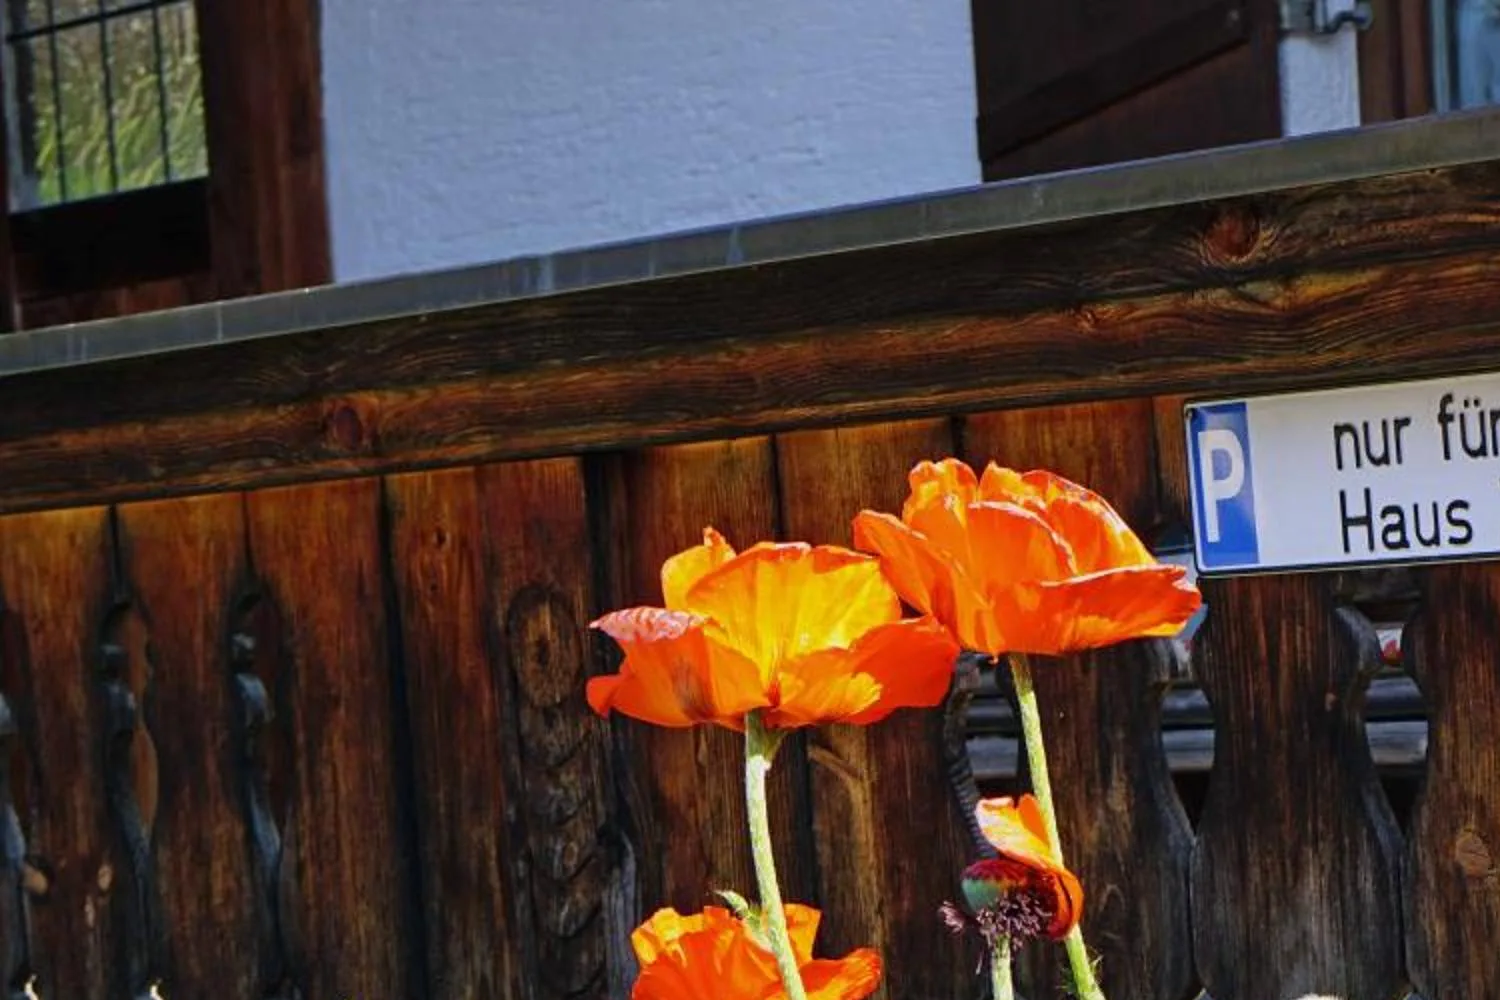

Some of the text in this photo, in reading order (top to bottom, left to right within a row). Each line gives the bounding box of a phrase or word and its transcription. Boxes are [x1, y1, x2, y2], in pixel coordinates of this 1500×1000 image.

[1333, 416, 1412, 471] nur
[1198, 429, 1245, 543] P
[1338, 486, 1474, 554] Haus
